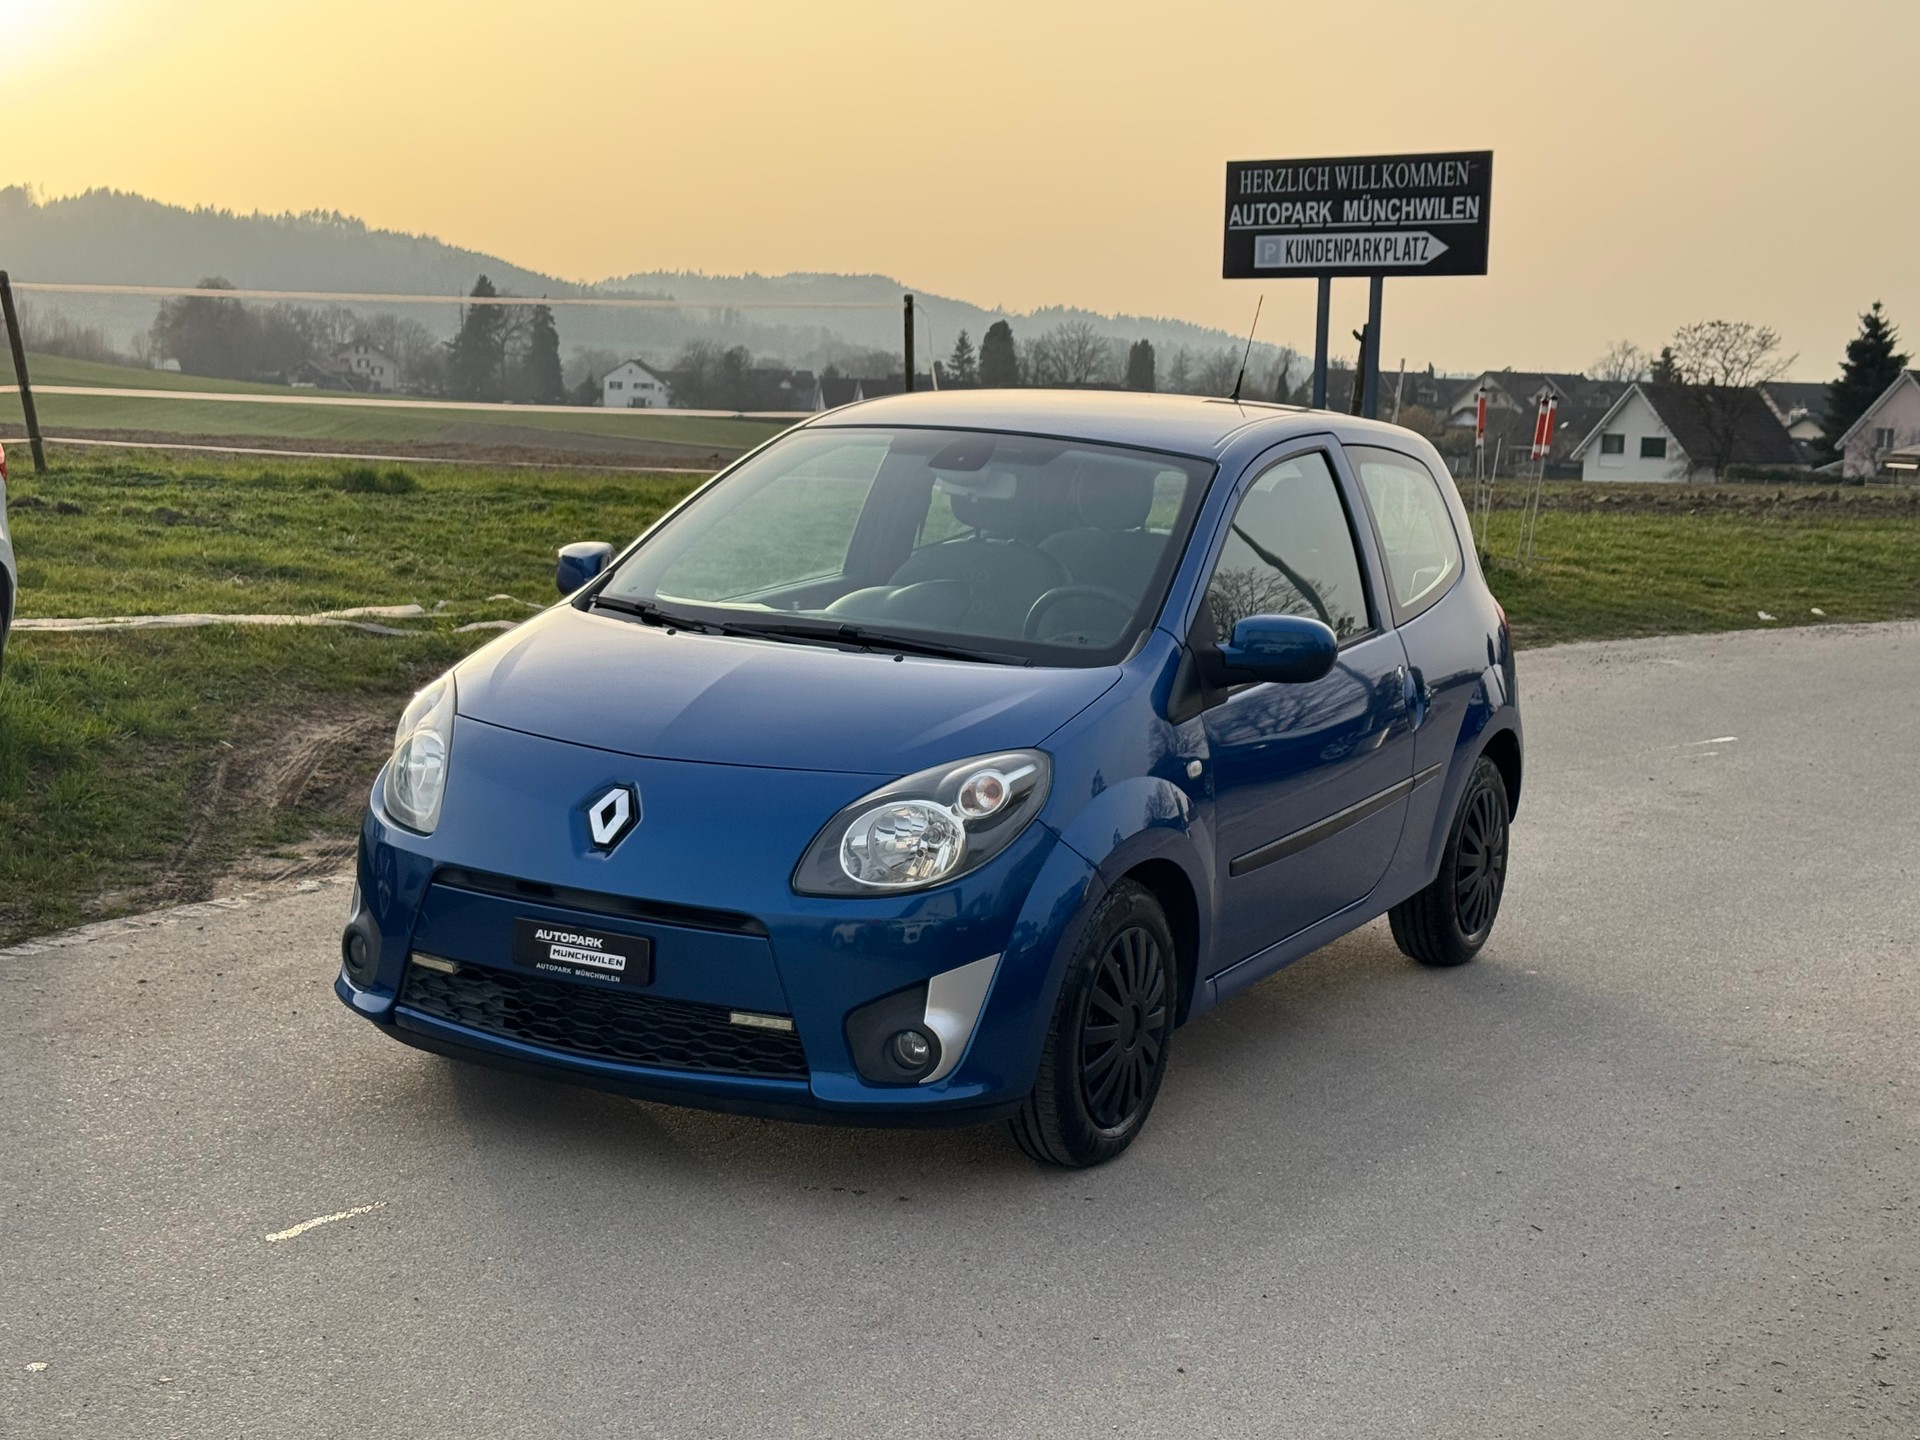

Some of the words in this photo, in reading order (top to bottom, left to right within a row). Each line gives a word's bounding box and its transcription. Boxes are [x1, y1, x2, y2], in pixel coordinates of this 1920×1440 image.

[1240, 166, 1329, 194] HERZLICH
[1335, 161, 1470, 190] WILLKOMMEN
[1229, 201, 1332, 225] AUTOPARK
[1343, 194, 1480, 222] MÜNCHWILEN
[1264, 243, 1276, 260] P
[1285, 237, 1429, 263] KUNDENPARKPLATZ
[535, 929, 603, 948] AUTOPARK
[552, 948, 623, 967] MÜNCHWILEN
[536, 962, 572, 975] AUTOPARK
[575, 968, 620, 983] MÜNCHWILEN
